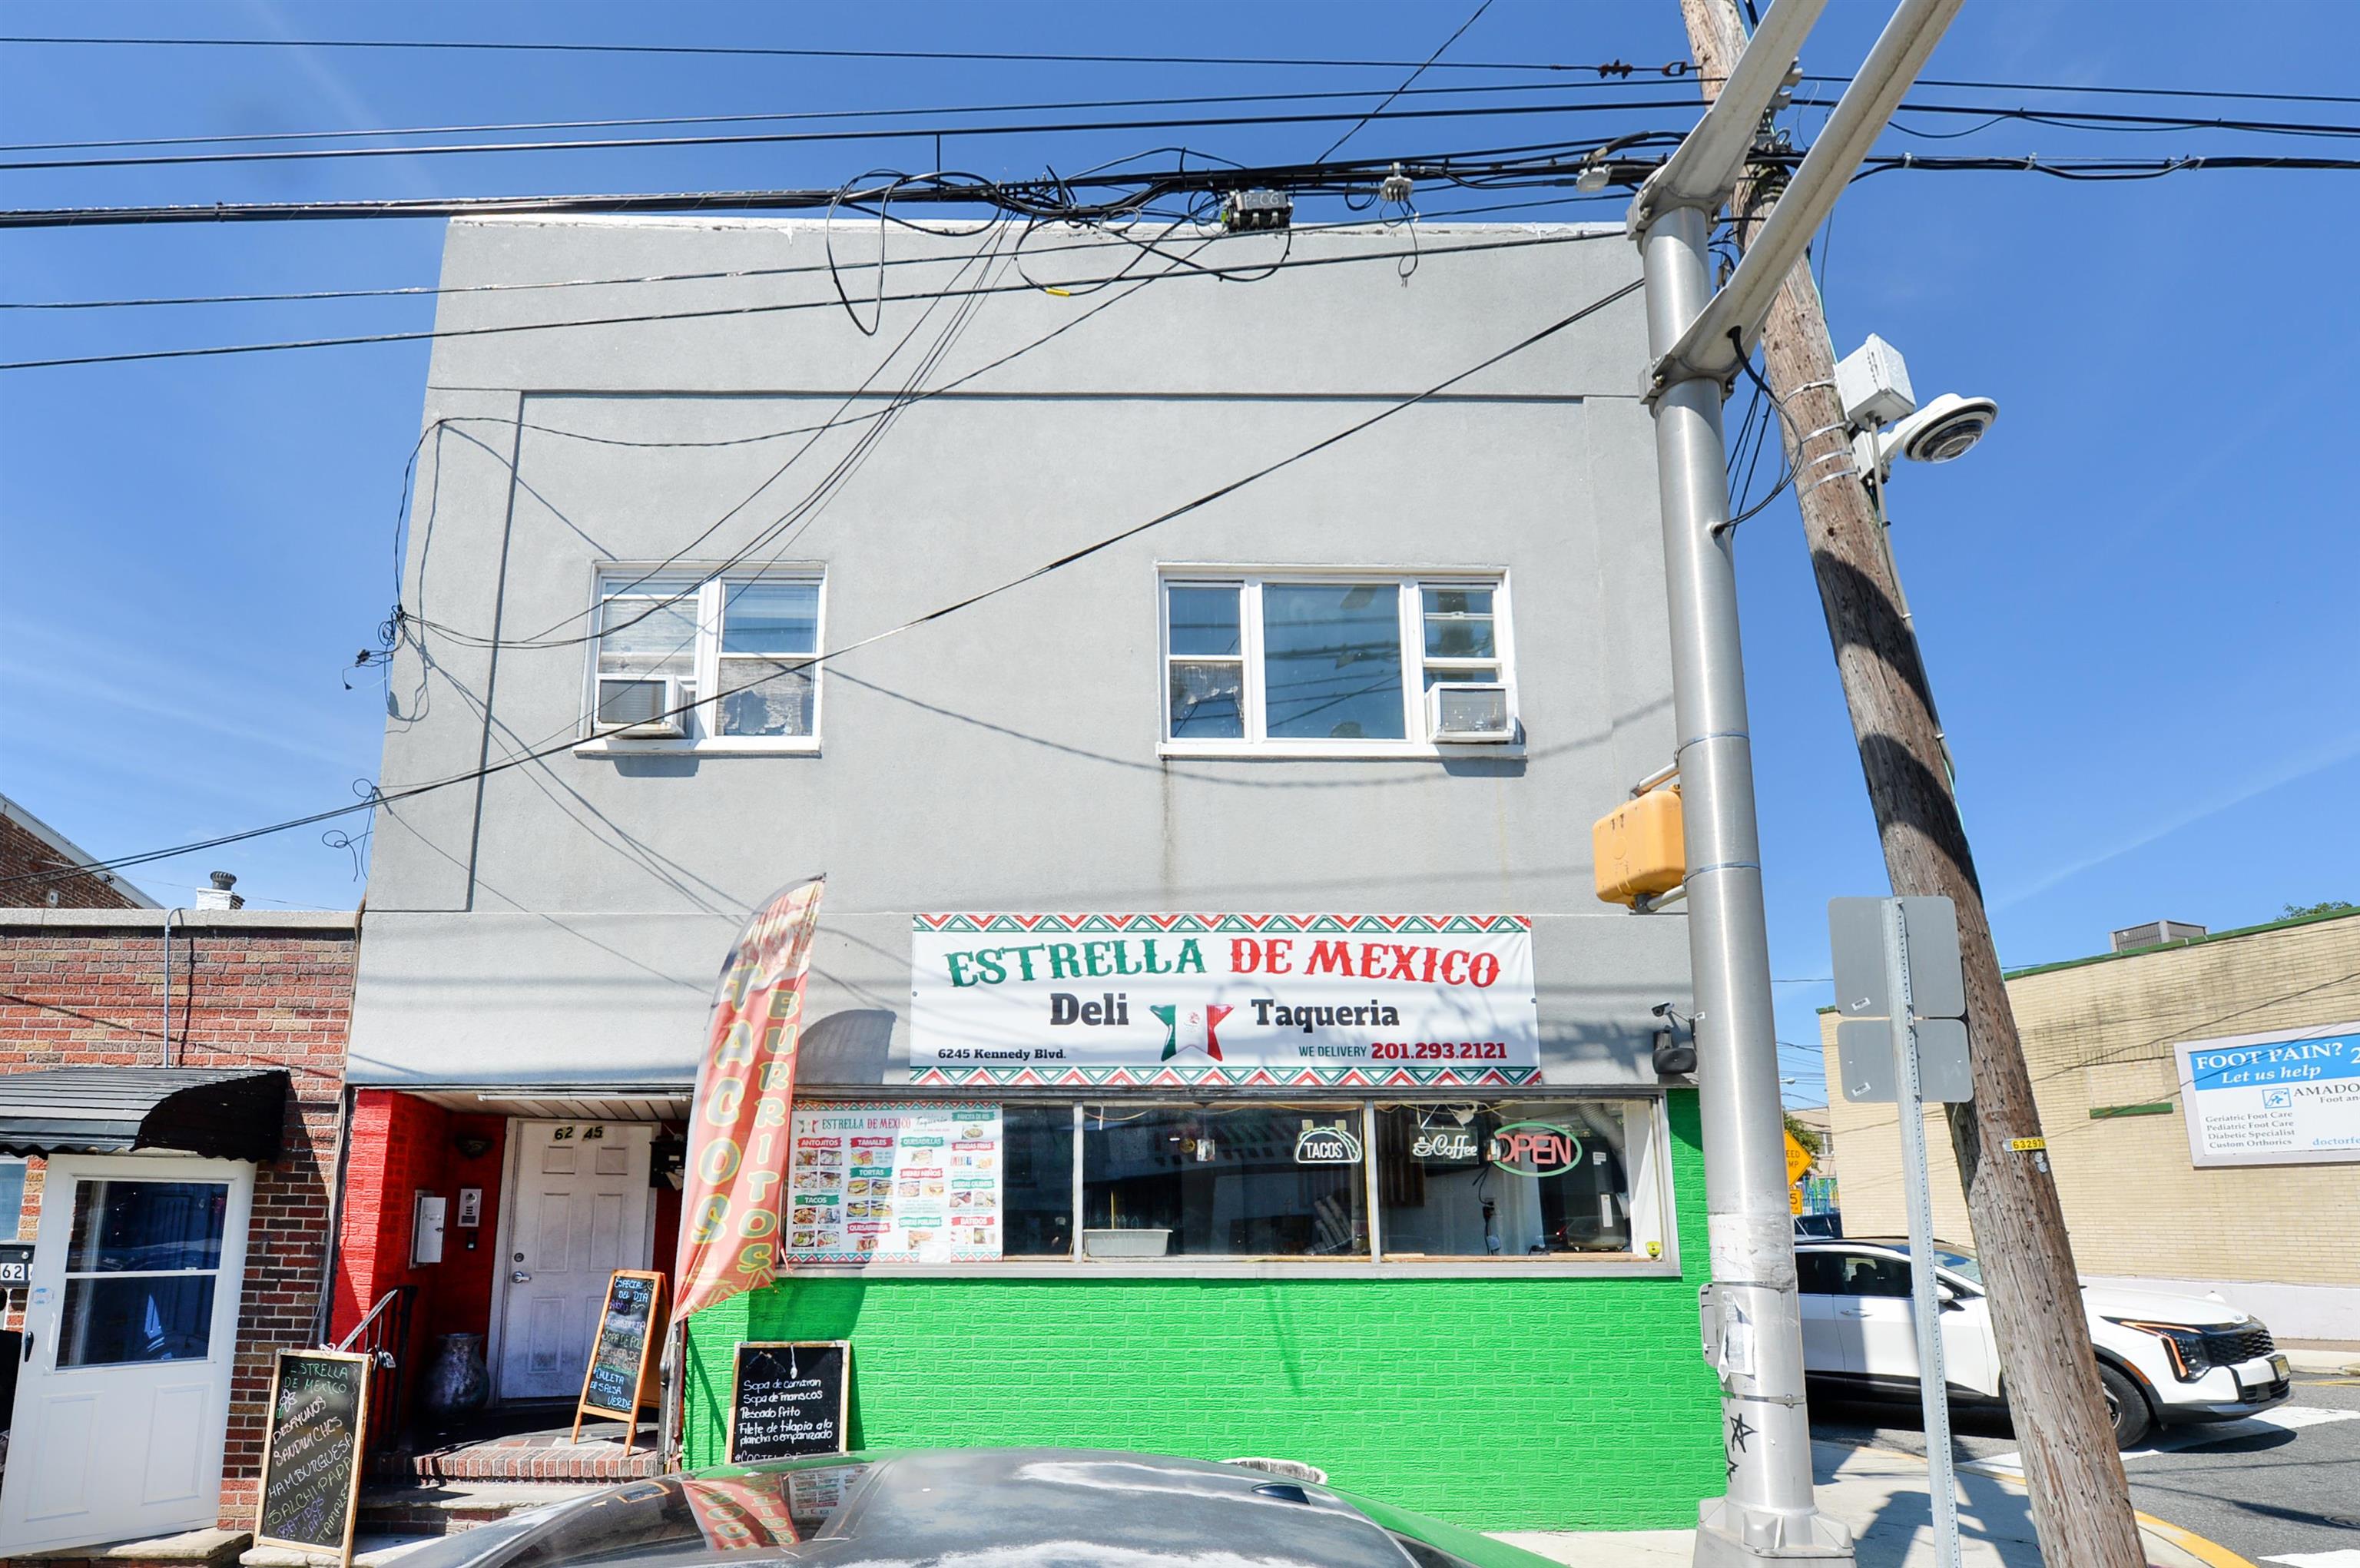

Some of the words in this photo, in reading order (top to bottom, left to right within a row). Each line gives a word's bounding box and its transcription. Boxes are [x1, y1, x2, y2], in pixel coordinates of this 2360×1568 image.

[946, 938, 1208, 988] ESTRELLA
[1228, 938, 1293, 974] DE
[1304, 940, 1501, 989] MEXICO
[1049, 993, 1129, 1027] Deli
[1251, 999, 1400, 1033] Taqueria
[937, 1048, 970, 1060] 6245
[973, 1048, 1030, 1062] Kennedy
[1033, 1047, 1066, 1060] Blvd.
[1298, 1047, 1315, 1058] WE
[1318, 1046, 1367, 1058] DELIVERY
[1371, 1042, 1506, 1060] 201.293.2121
[2196, 1050, 2261, 1070] FOOT
[2268, 1042, 2343, 1063] PAIN?
[2222, 1071, 2249, 1084] Let
[2255, 1070, 2275, 1081] us
[2281, 1064, 2322, 1079] help
[691, 964, 764, 1245] TACOS
[822, 1118, 863, 1129] ESTRELLA
[867, 1118, 877, 1129] DE
[879, 1118, 910, 1129] MEXICO
[2205, 1114, 2246, 1122] Geriatric
[554, 1126, 573, 1140] 62
[582, 1126, 603, 1139] 45
[737, 989, 801, 1275] BURRITOS
[2206, 1122, 2246, 1131] Pediatric
[2248, 1129, 2295, 1139] Specialist
[1304, 1142, 1343, 1159] TACOS
[1431, 1134, 1479, 1160] Coffee
[1497, 1133, 1572, 1165] OPEN
[1786, 1149, 1800, 1159] EED
[1789, 1193, 1798, 1205] 5
[618, 1291, 630, 1299] DEL
[633, 1292, 648, 1302] DIA
[283, 1376, 298, 1389] DE
[304, 1377, 347, 1394] MEXICO
[598, 1382, 621, 1395] SALSA
[744, 1380, 771, 1394] Sopa
[772, 1379, 782, 1389] de
[744, 1394, 767, 1407] Sopa
[768, 1392, 779, 1403] de
[740, 1406, 777, 1419] Pescado
[778, 1406, 800, 1418] frito
[766, 1421, 778, 1433] de
[780, 1419, 813, 1432] tilapia
[740, 1434, 771, 1447] plancha
[302, 1509, 326, 1540] CAFE
